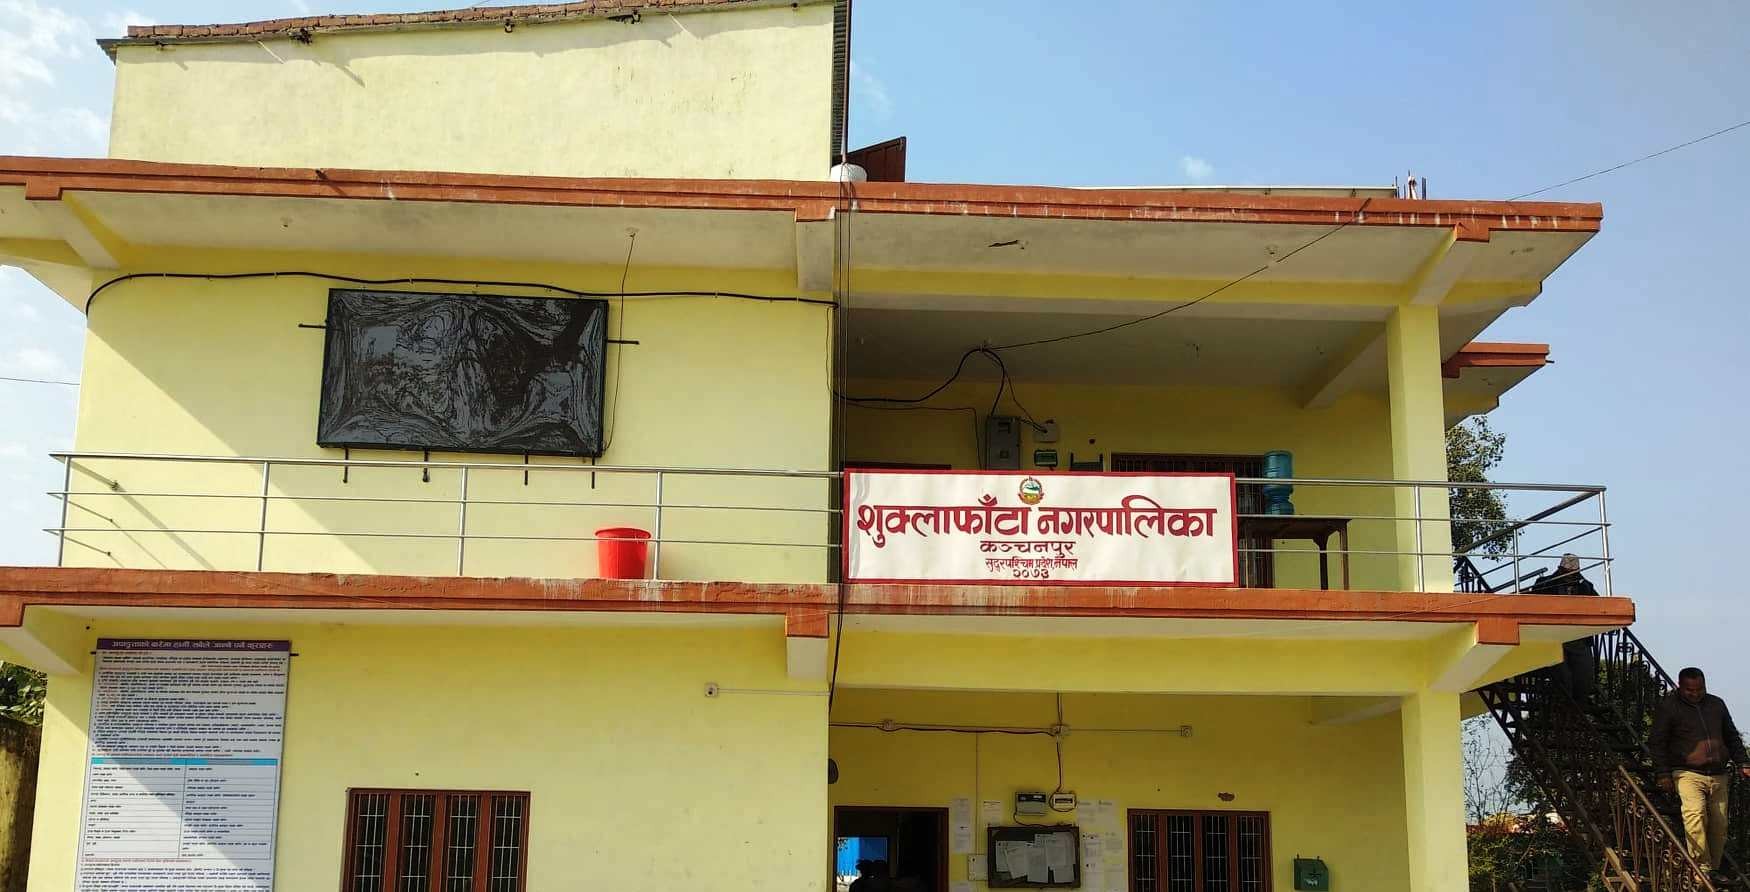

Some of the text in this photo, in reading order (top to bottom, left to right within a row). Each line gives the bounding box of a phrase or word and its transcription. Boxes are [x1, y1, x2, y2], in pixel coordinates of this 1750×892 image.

[857, 494, 1218, 548] शुक्लाफाँटा नगरपालिका
[980, 541, 1077, 559] कञ्चनपुर
[1012, 569, 1050, 579] २०७३
